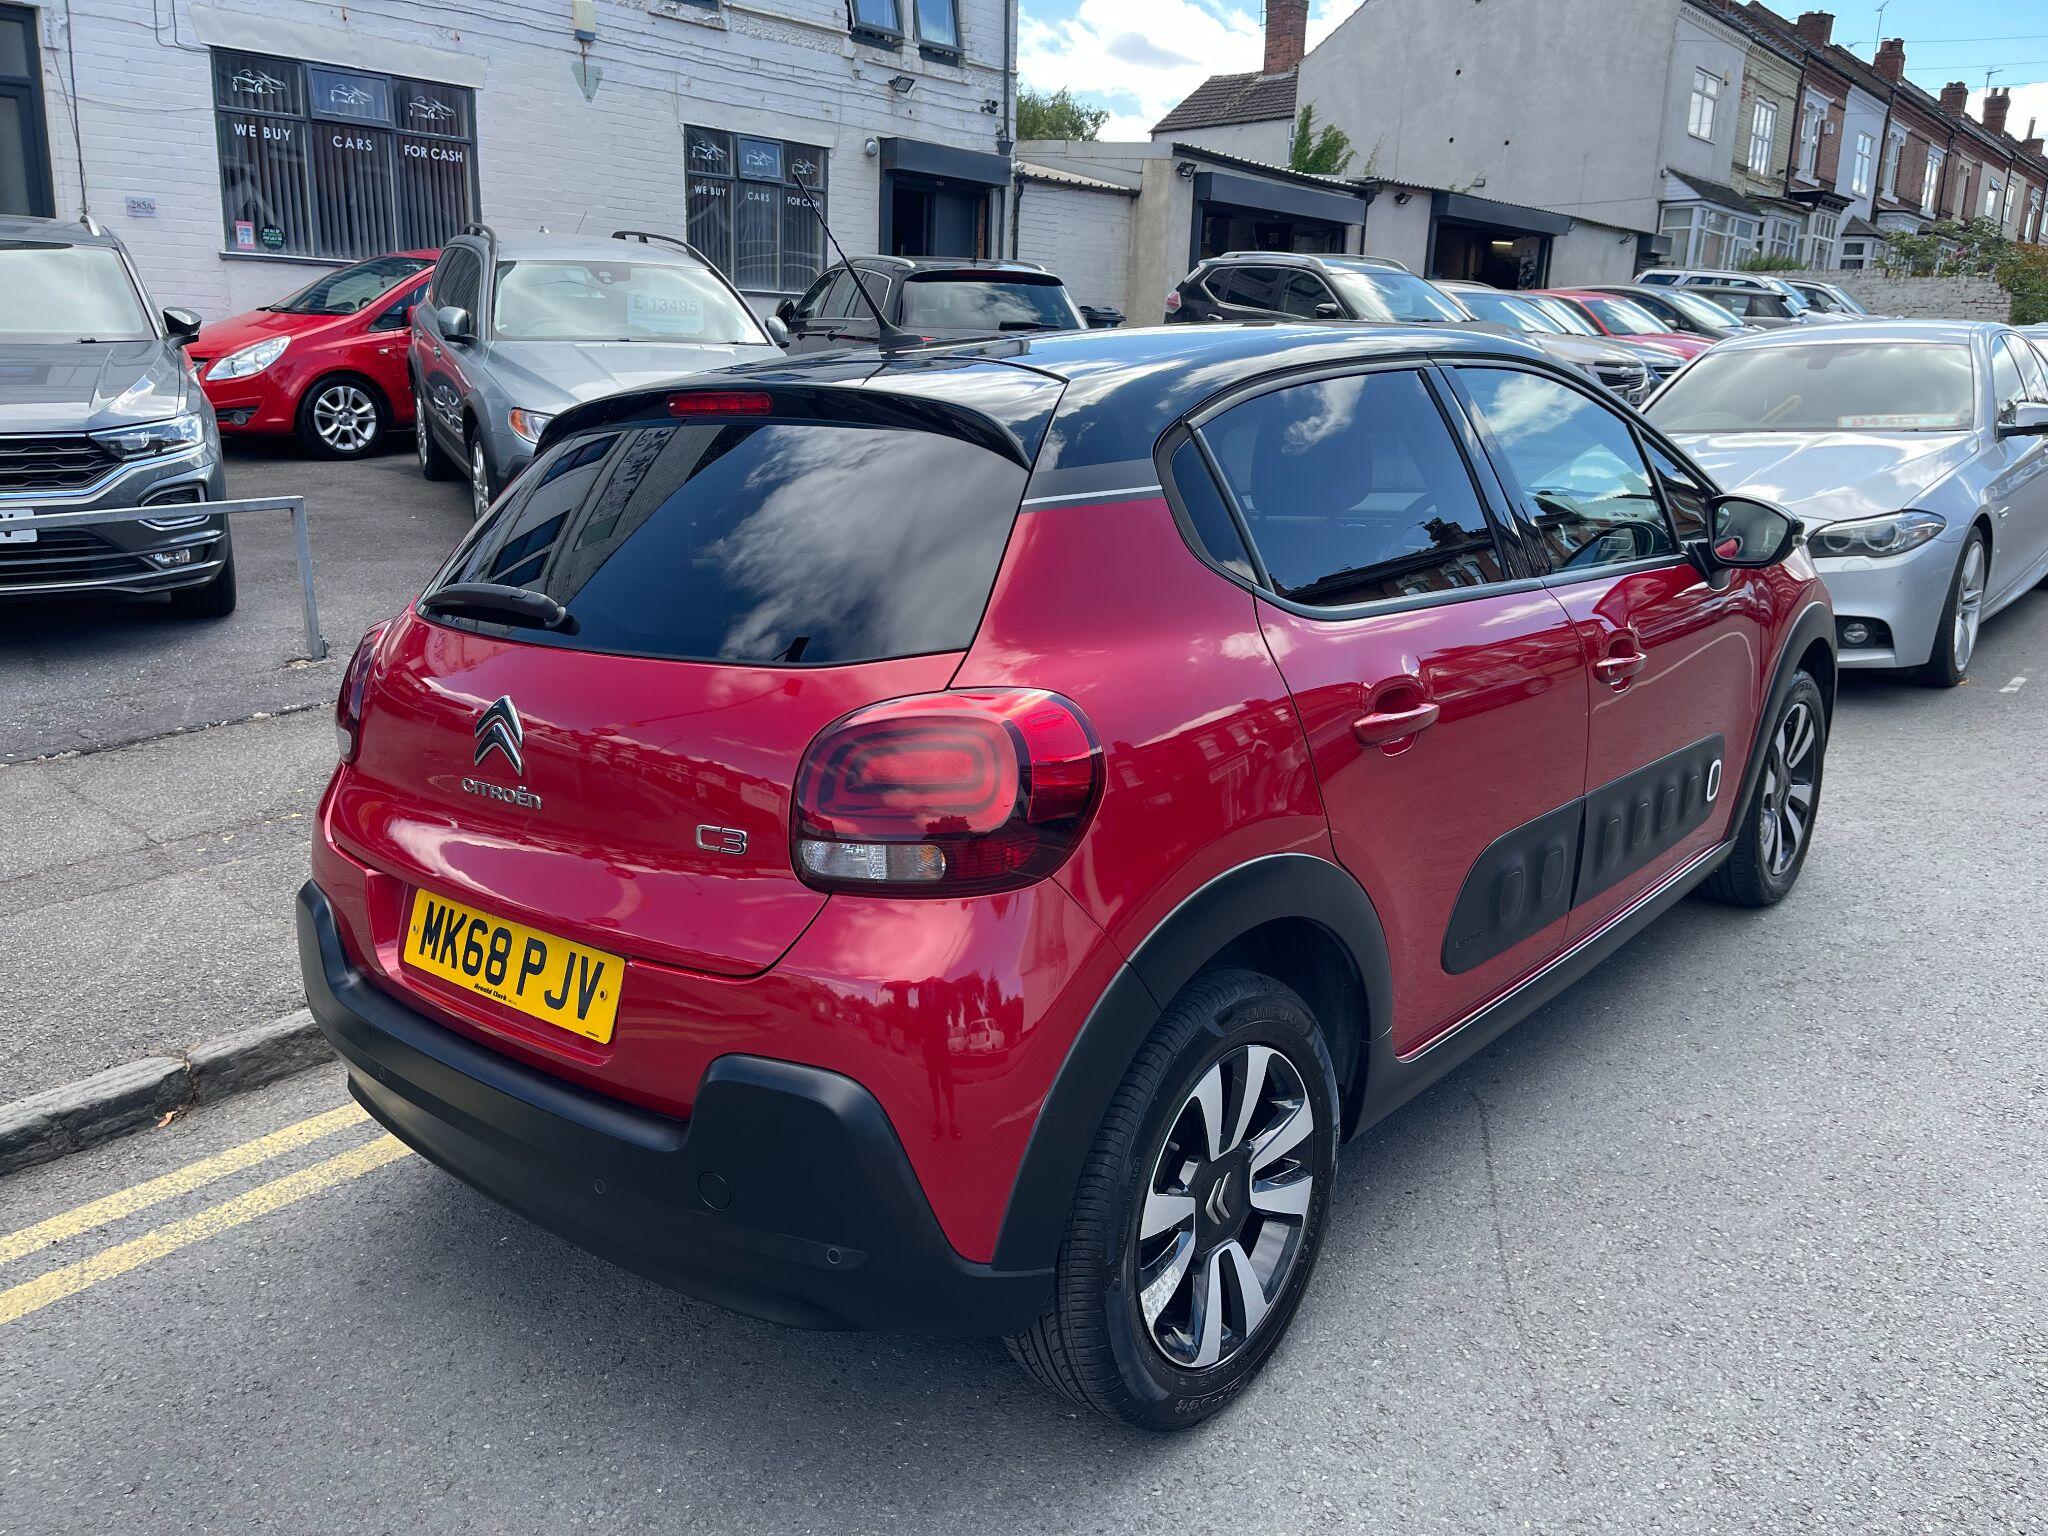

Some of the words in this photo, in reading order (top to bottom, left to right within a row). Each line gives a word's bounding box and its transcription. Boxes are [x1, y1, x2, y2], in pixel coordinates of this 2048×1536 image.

[233, 123, 257, 138] WE
[263, 126, 291, 141] BUY
[332, 135, 373, 151] CARS
[404, 144, 428, 158] FOR
[430, 147, 463, 163] CASH
[694, 184, 708, 195] WE
[710, 186, 726, 197] BUY
[747, 191, 770, 203] CARS
[787, 196, 800, 206] FOR
[696, 824, 748, 855] C3
[418, 901, 513, 986] MK68
[516, 937, 605, 1021] PJV
